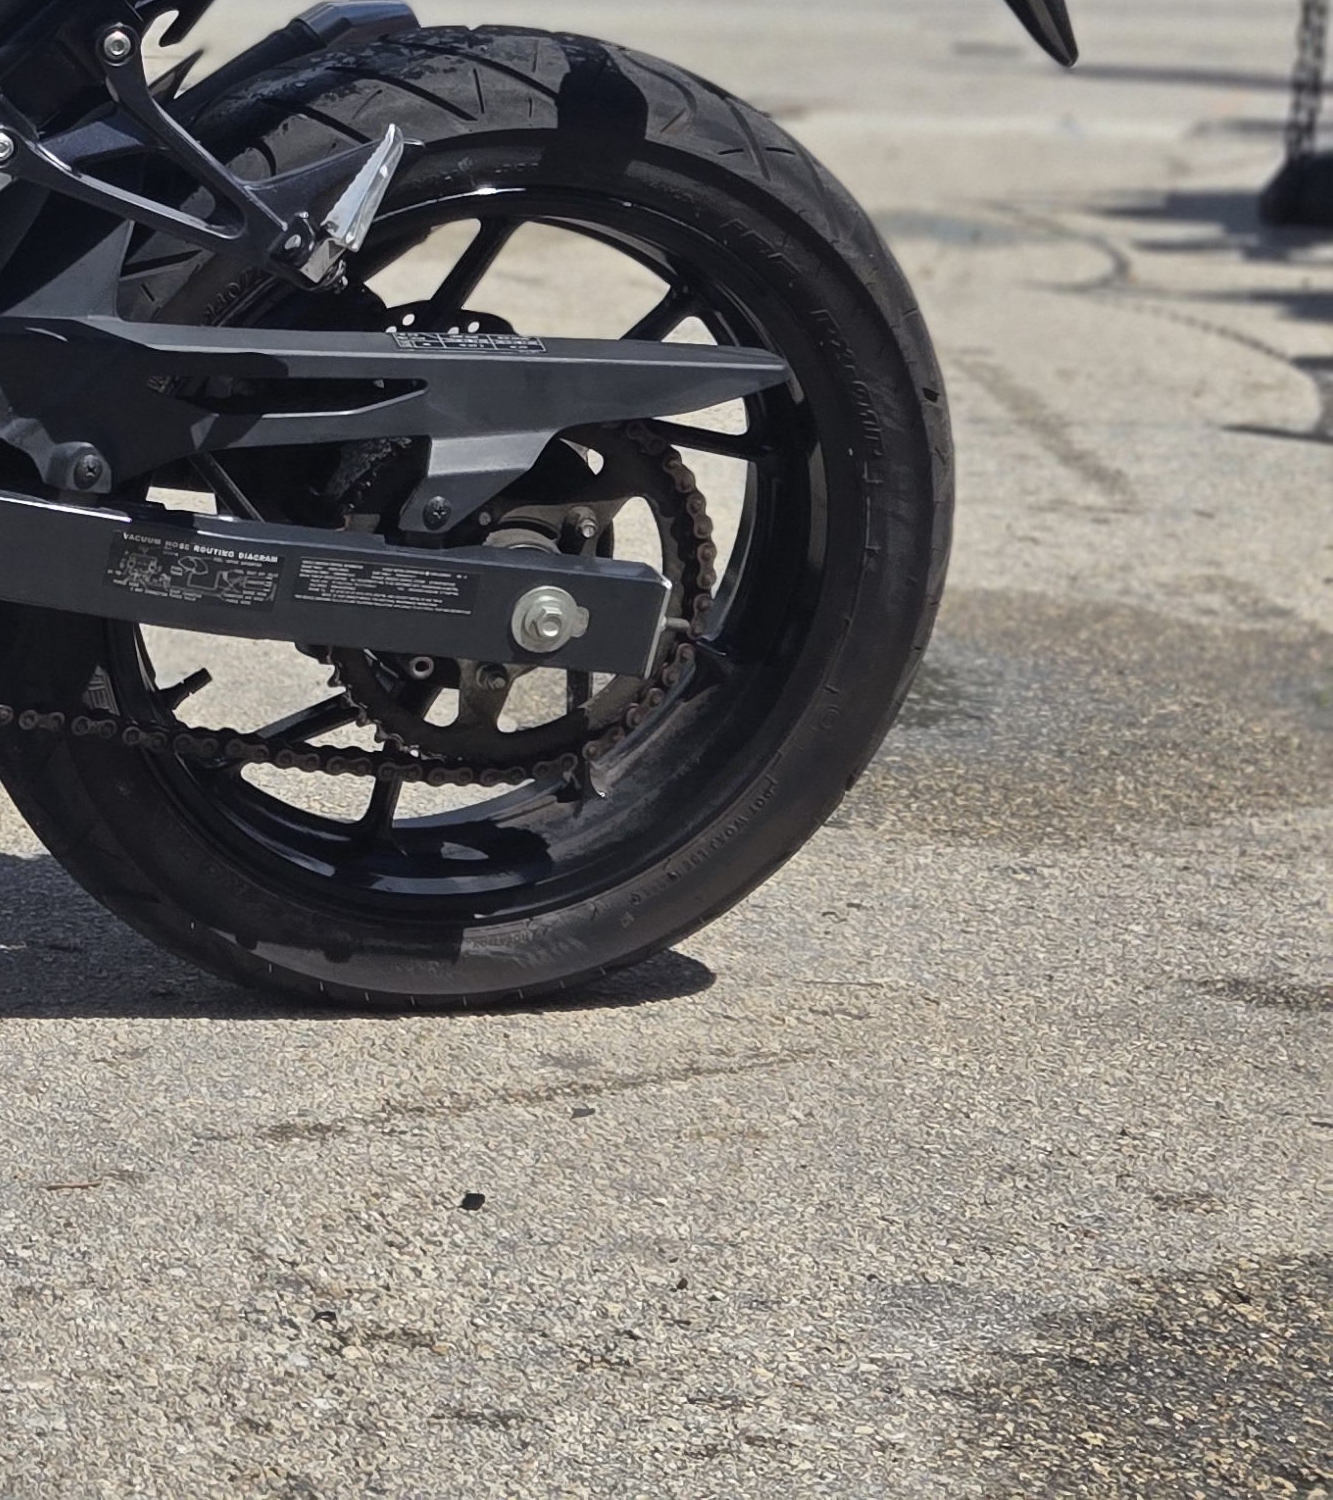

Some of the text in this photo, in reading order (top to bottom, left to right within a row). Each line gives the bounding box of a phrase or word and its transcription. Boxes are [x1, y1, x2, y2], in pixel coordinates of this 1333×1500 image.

[122, 531, 162, 545] VACUUM
[193, 544, 235, 558] ROUTING
[238, 551, 278, 563] DIAGRAM
